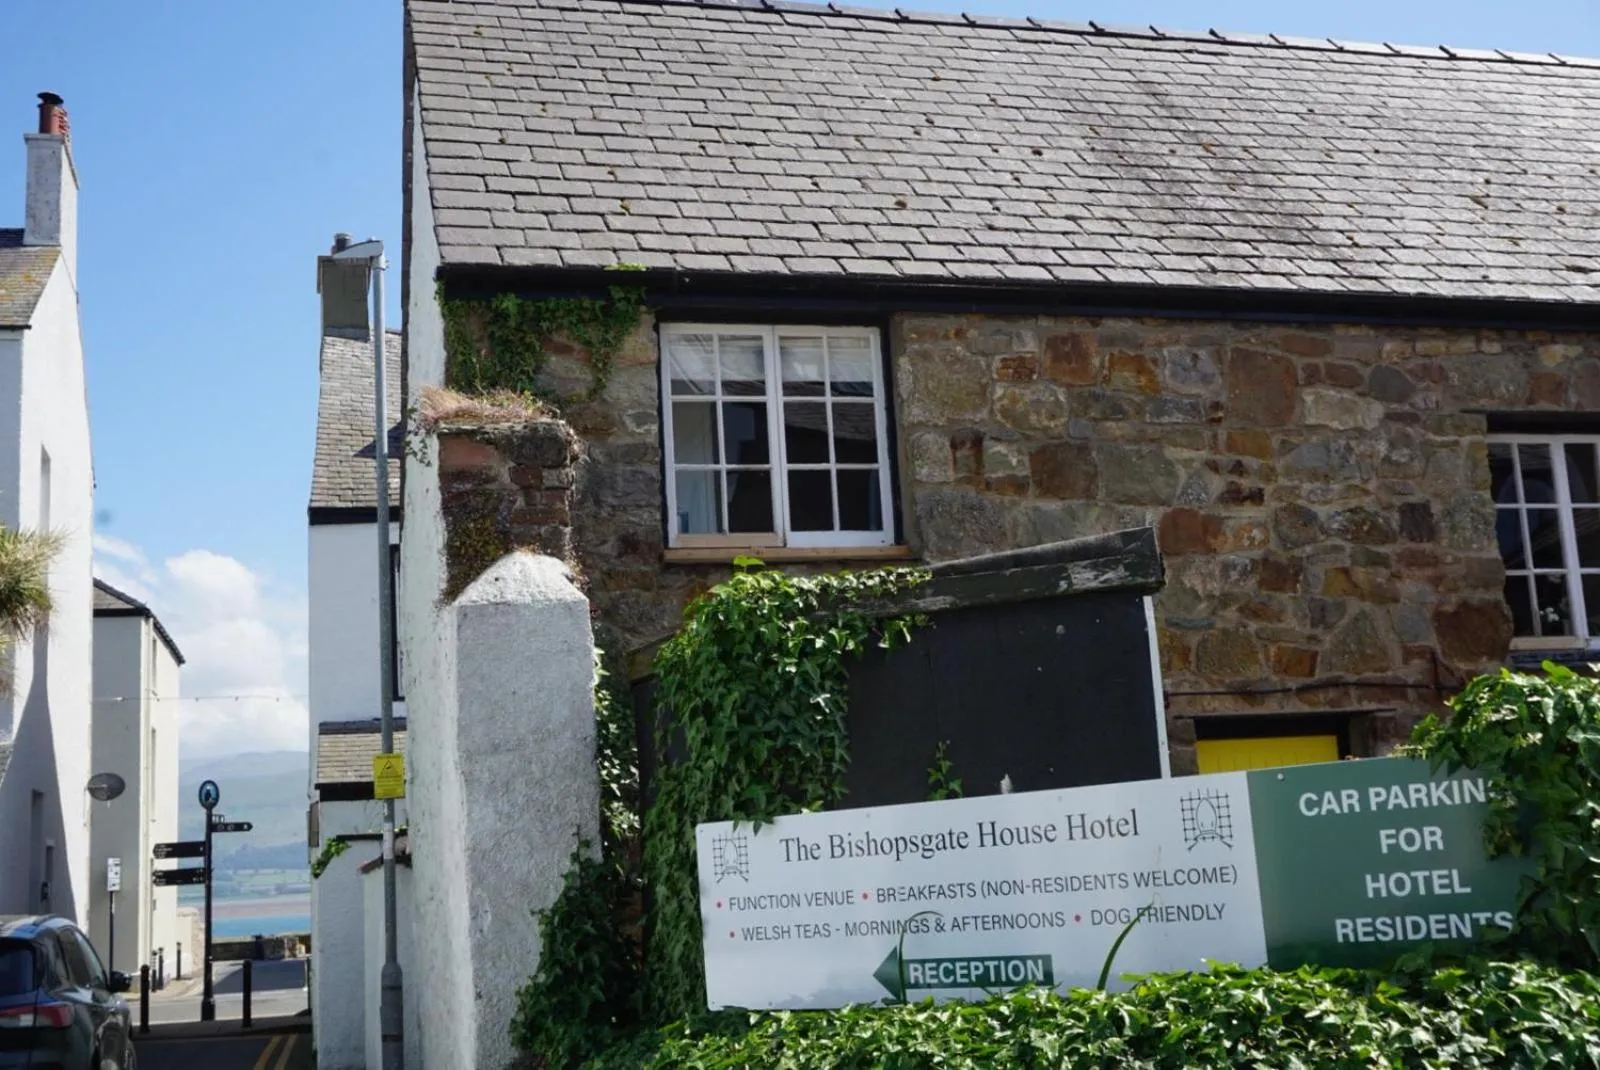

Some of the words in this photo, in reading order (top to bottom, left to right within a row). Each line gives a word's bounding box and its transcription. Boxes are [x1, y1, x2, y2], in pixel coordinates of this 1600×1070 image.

[1299, 789, 1361, 817] CAR
[779, 836, 821, 862] The
[828, 827, 970, 862] Bishopsgate
[976, 820, 1058, 848] House
[1066, 808, 1140, 841] Hotel
[1379, 826, 1444, 853] FOR
[876, 882, 977, 903] BREAKFASTS
[981, 872, 1130, 899] (NON-RESIDENTS
[1133, 864, 1238, 888] WELCOME)
[1365, 868, 1472, 898] HOTEL
[728, 893, 802, 912] FUNCTION
[803, 890, 855, 908] VENUE
[1091, 908, 1131, 926] DOG
[1136, 903, 1226, 923] FRIENDLY
[742, 924, 791, 942] WELSH
[795, 922, 832, 939] TEAS
[844, 918, 930, 937] MORNINGS
[934, 919, 946, 933] &
[951, 911, 1066, 933] AFTERNOONS
[908, 958, 1045, 985] RECEPTION
